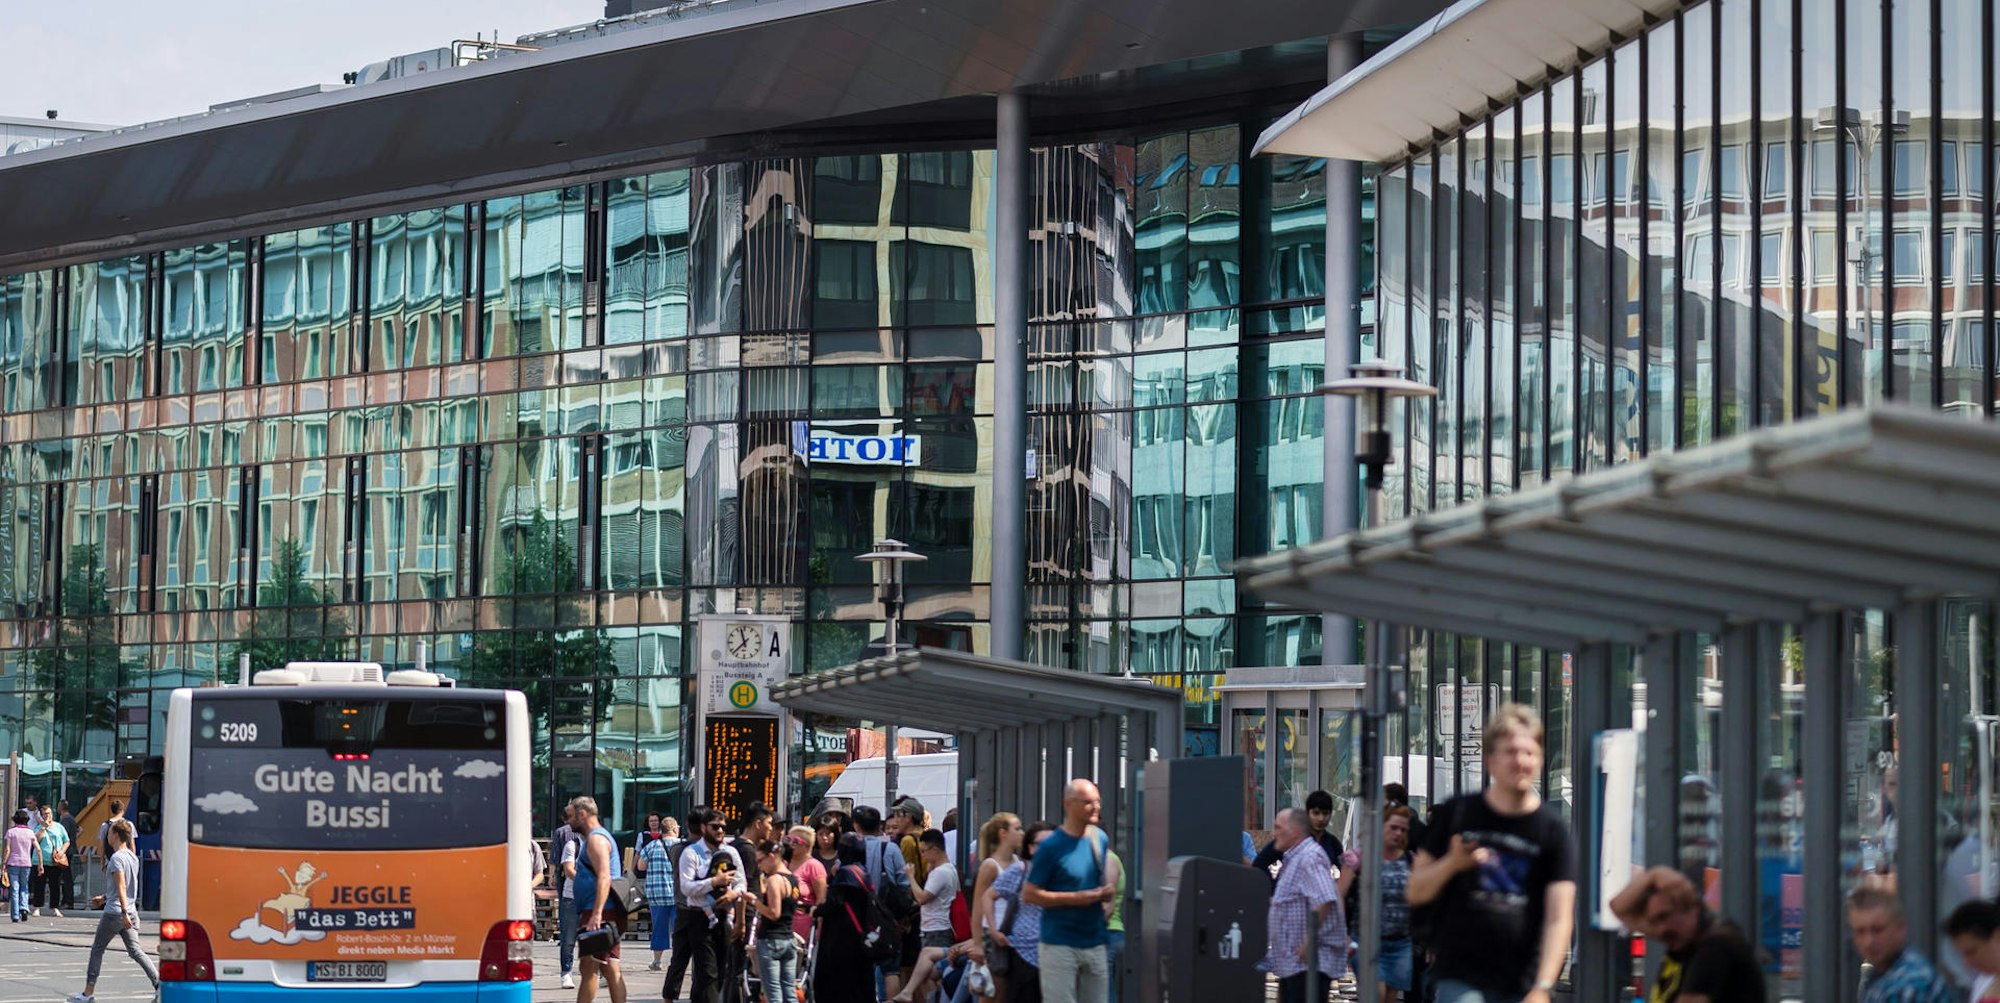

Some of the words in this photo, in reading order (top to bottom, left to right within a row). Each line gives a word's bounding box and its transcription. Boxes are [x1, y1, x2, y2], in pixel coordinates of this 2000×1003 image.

[769, 631, 780, 657] A
[718, 661, 770, 669] Hauptbahnhof
[724, 672, 755, 680] Bussteig
[220, 722, 258, 742] 5209
[254, 764, 335, 792] Gute
[346, 764, 443, 793] Nacht
[306, 799, 390, 828] Bussi
[330, 886, 412, 904] JEGGLE
[298, 911, 346, 927] "das
[354, 911, 413, 927] Bett"
[406, 934, 412, 942] 2
[414, 934, 421, 942] in
[423, 933, 456, 943] Münster
[337, 945, 365, 954] direkt
[367, 945, 395, 954] neben
[397, 945, 425, 954] Media
[427, 945, 455, 954] Markt
[316, 964, 331, 977] MS
[356, 964, 384, 977] 8000
